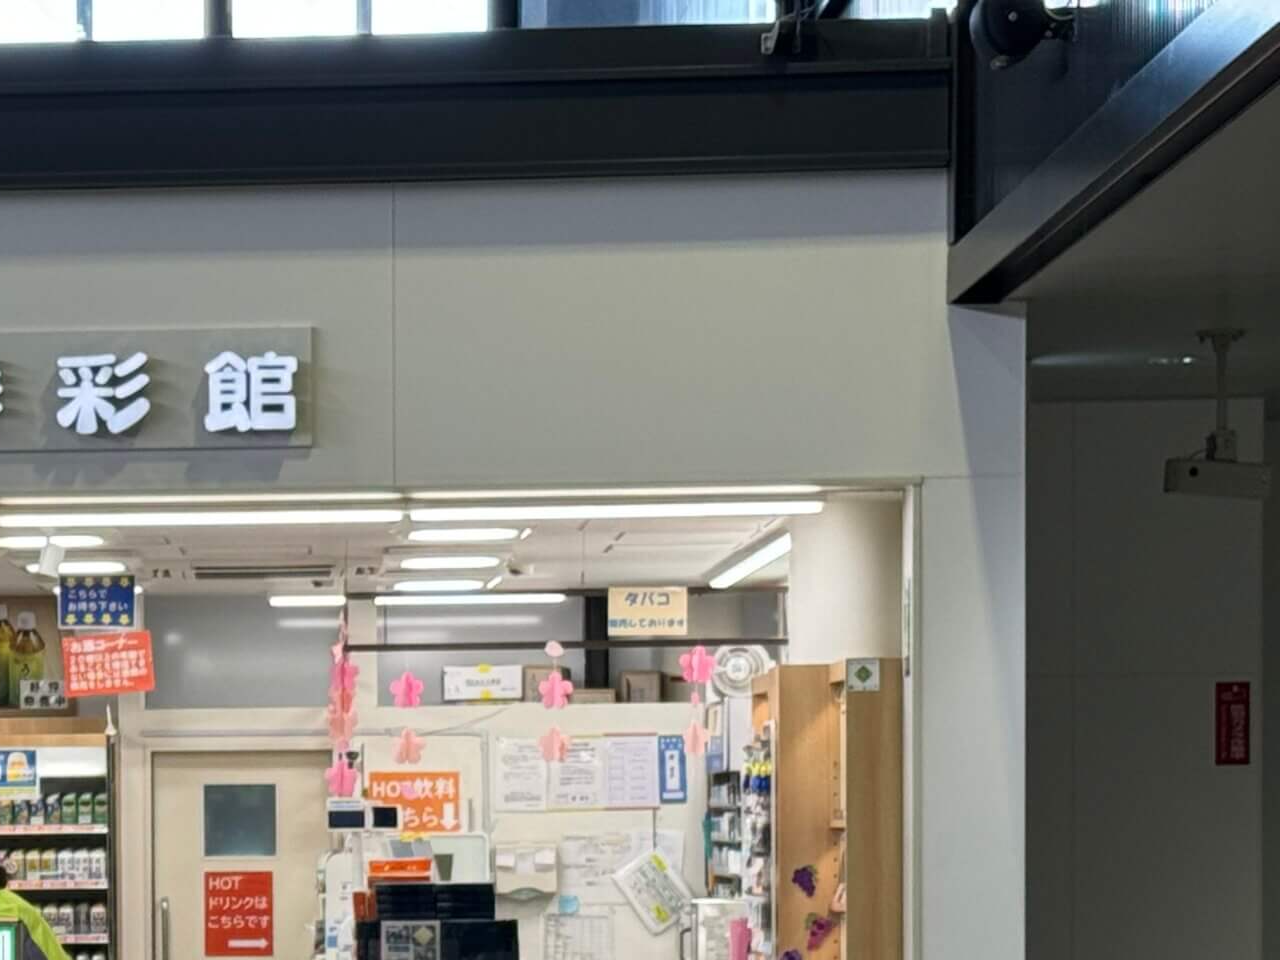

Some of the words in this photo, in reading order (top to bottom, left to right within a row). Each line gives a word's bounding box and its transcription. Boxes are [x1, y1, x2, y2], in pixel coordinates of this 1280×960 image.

[624, 592, 670, 606] タバコ
[404, 807, 438, 828] ちら
[208, 877, 242, 890] HOT
[208, 896, 268, 910] ドリンクは
[208, 914, 271, 928] こちらです
